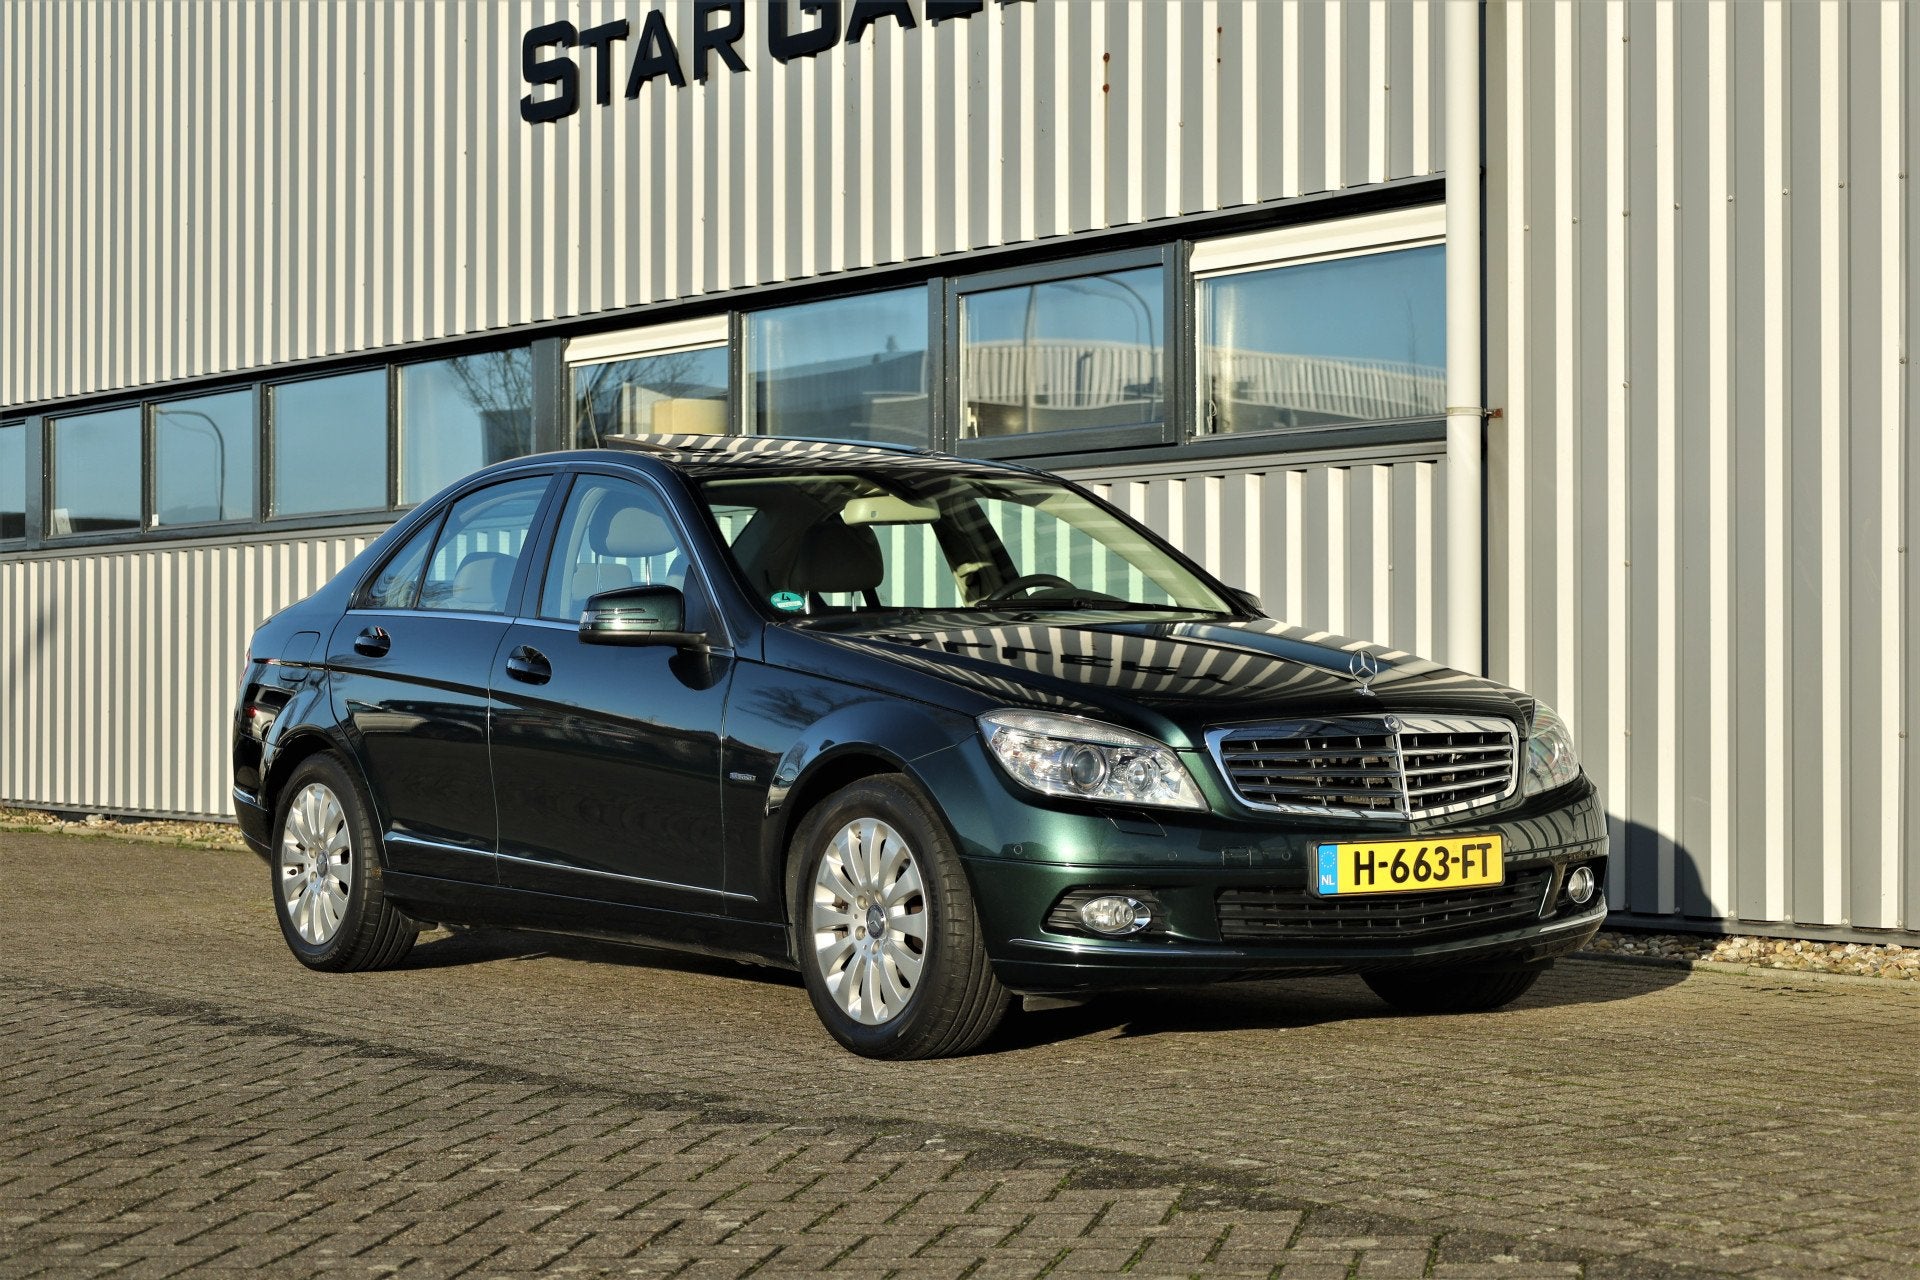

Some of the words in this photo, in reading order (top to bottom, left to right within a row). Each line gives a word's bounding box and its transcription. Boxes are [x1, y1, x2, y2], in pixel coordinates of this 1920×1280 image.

[520, 0, 750, 124] STAR
[1321, 873, 1335, 886] NL
[1353, 842, 1493, 886] H-663-FT
